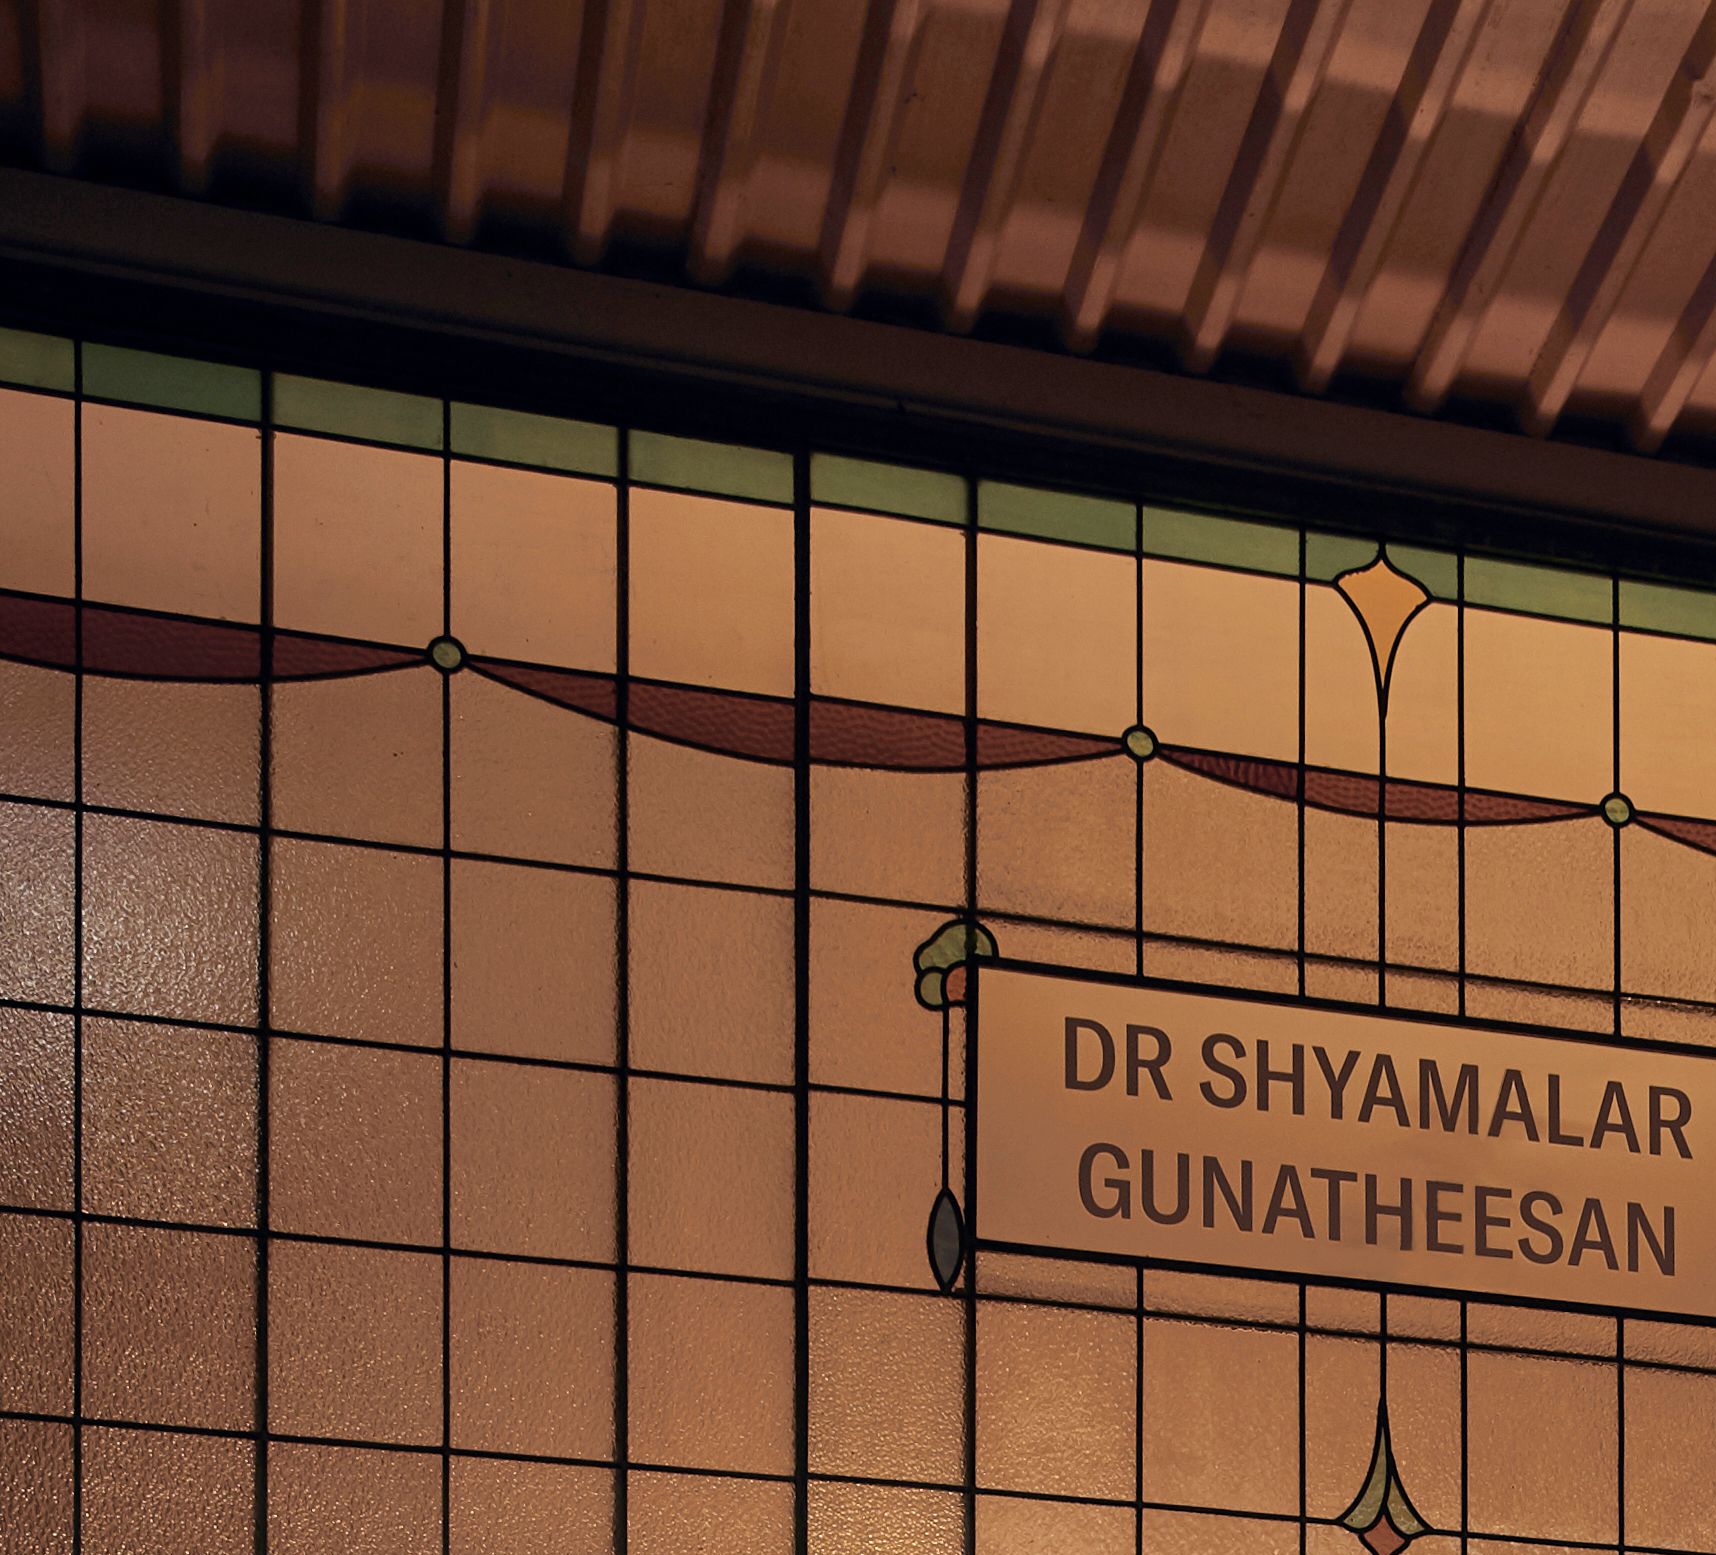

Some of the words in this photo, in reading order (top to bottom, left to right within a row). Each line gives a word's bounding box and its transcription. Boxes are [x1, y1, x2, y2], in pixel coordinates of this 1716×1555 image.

[1063, 1016, 1173, 1101] DR
[1199, 1032, 1694, 1160] SHYAMALAR
[1077, 1141, 1677, 1277] GUNATHEESAN
